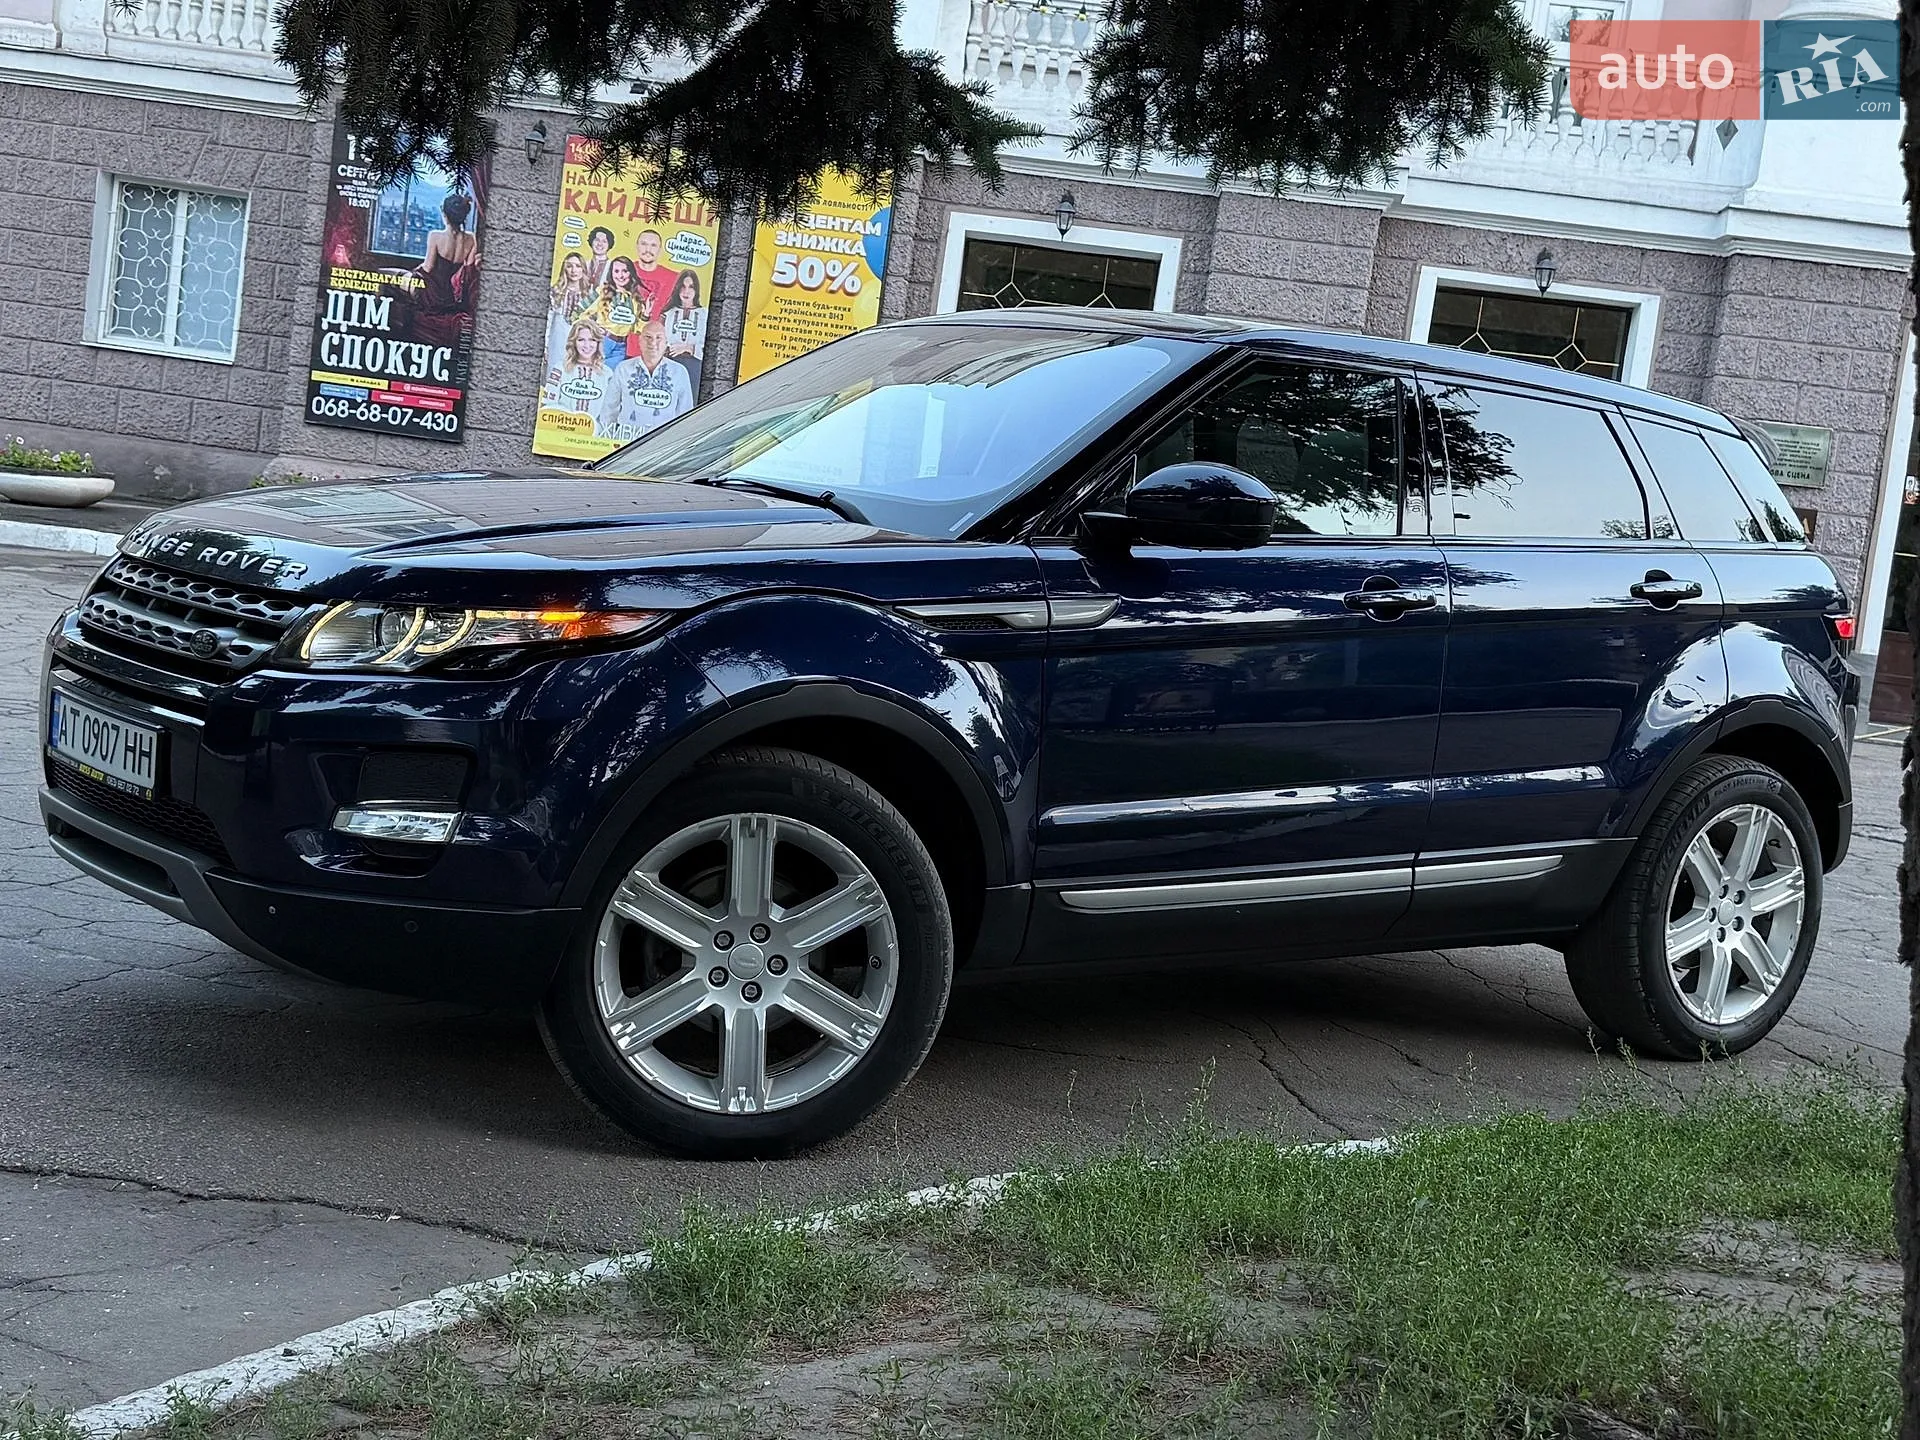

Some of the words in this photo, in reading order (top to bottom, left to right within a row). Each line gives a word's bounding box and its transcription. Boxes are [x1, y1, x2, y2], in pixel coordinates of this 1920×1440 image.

[774, 229, 867, 257] ЗНИЖКА
[330, 267, 427, 289] ЕКСТРАВАГАНТНА
[330, 276, 380, 293] КОМЕДІЯ
[770, 252, 863, 297] 50%
[321, 288, 394, 333] ДІМ
[774, 296, 811, 307] Студенти
[811, 300, 852, 313] будь-яких
[779, 307, 827, 319] українських
[761, 315, 791, 324] можуть
[793, 318, 829, 328] купувати
[781, 326, 813, 335] вистави
[320, 331, 453, 382] СПОКУС
[761, 339, 786, 350] Театру
[311, 396, 458, 433] 068-68-07-430
[1786, 471, 1810, 479] СЦЕНА
[130, 527, 193, 557] RANGE
[197, 546, 309, 580] ROVER
[60, 704, 80, 749] AT
[82, 714, 120, 765] 0907
[123, 729, 152, 778] HH
[831, 798, 934, 914] MICHELIN
